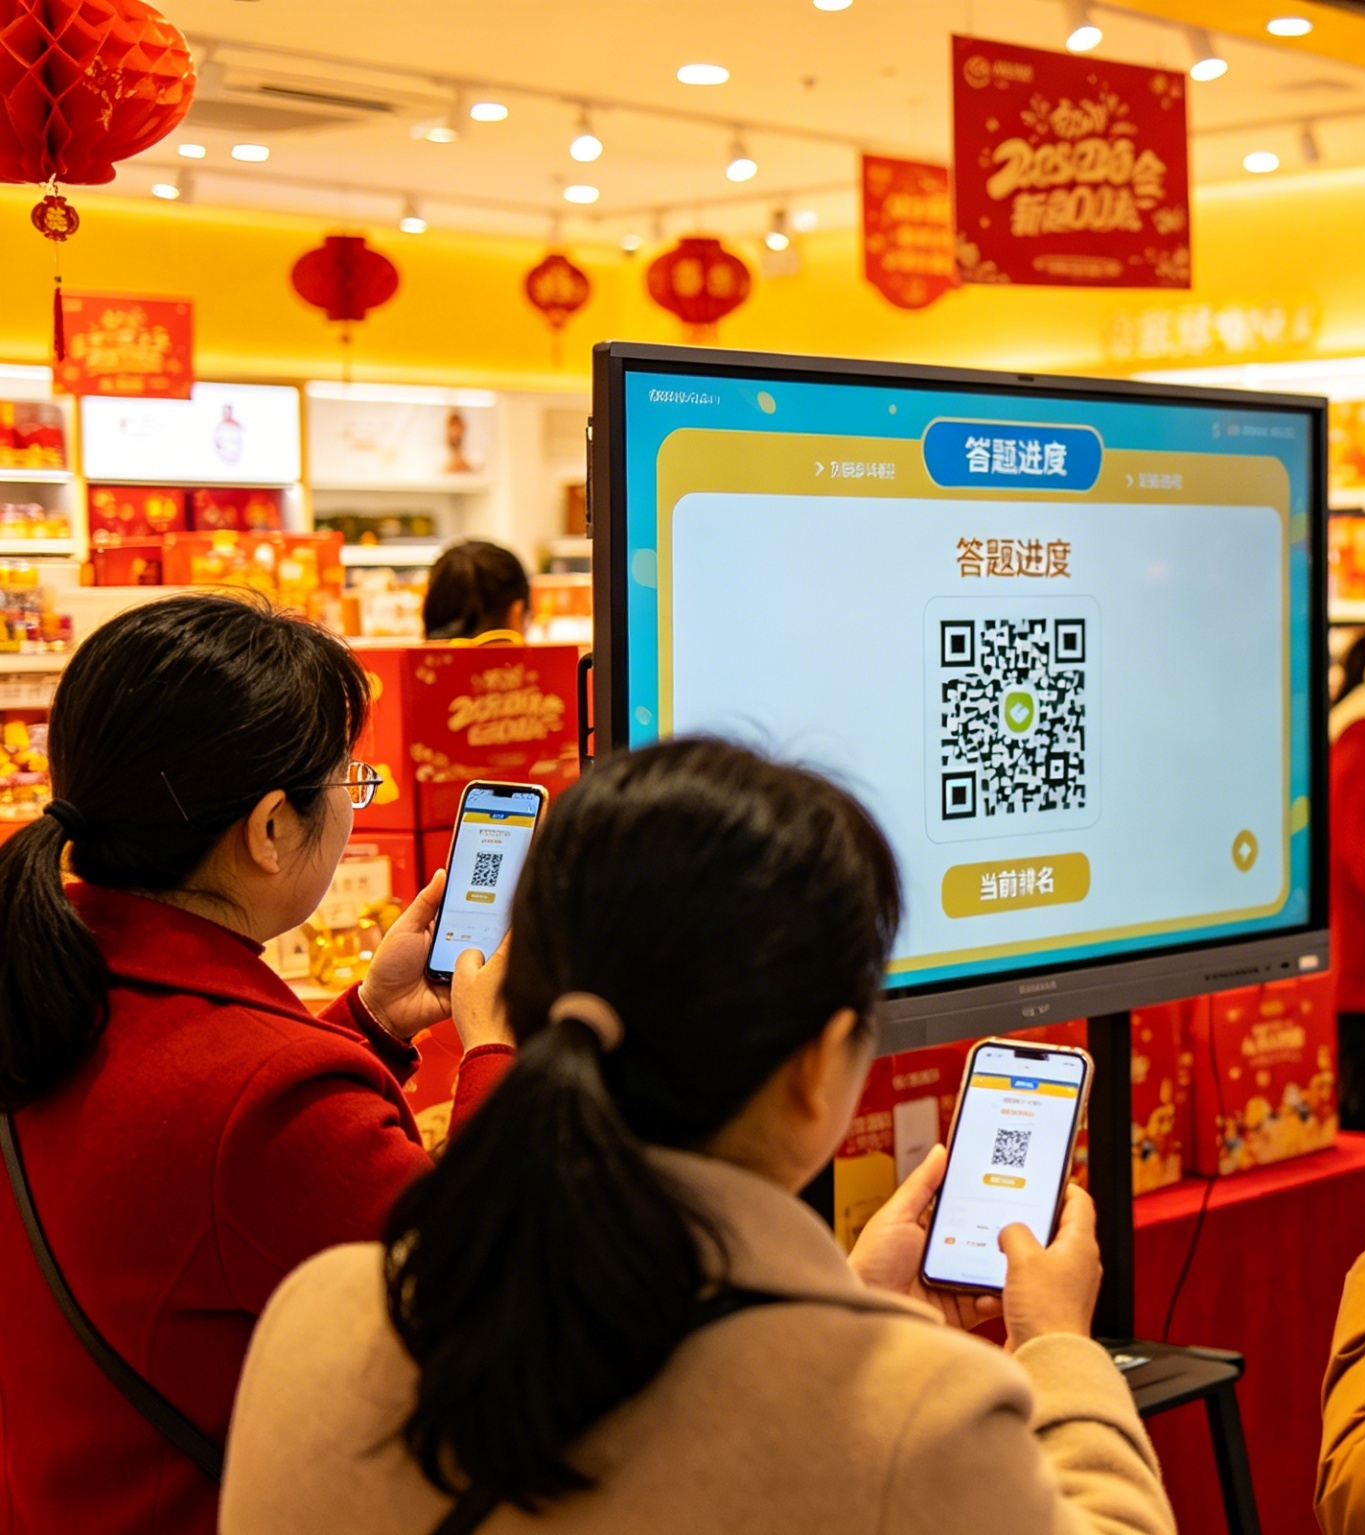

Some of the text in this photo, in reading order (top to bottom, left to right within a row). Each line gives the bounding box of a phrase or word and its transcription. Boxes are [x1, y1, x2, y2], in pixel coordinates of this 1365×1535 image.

[964, 435, 1068, 477] 答题进度
[956, 536, 1072, 579] 答题进度
